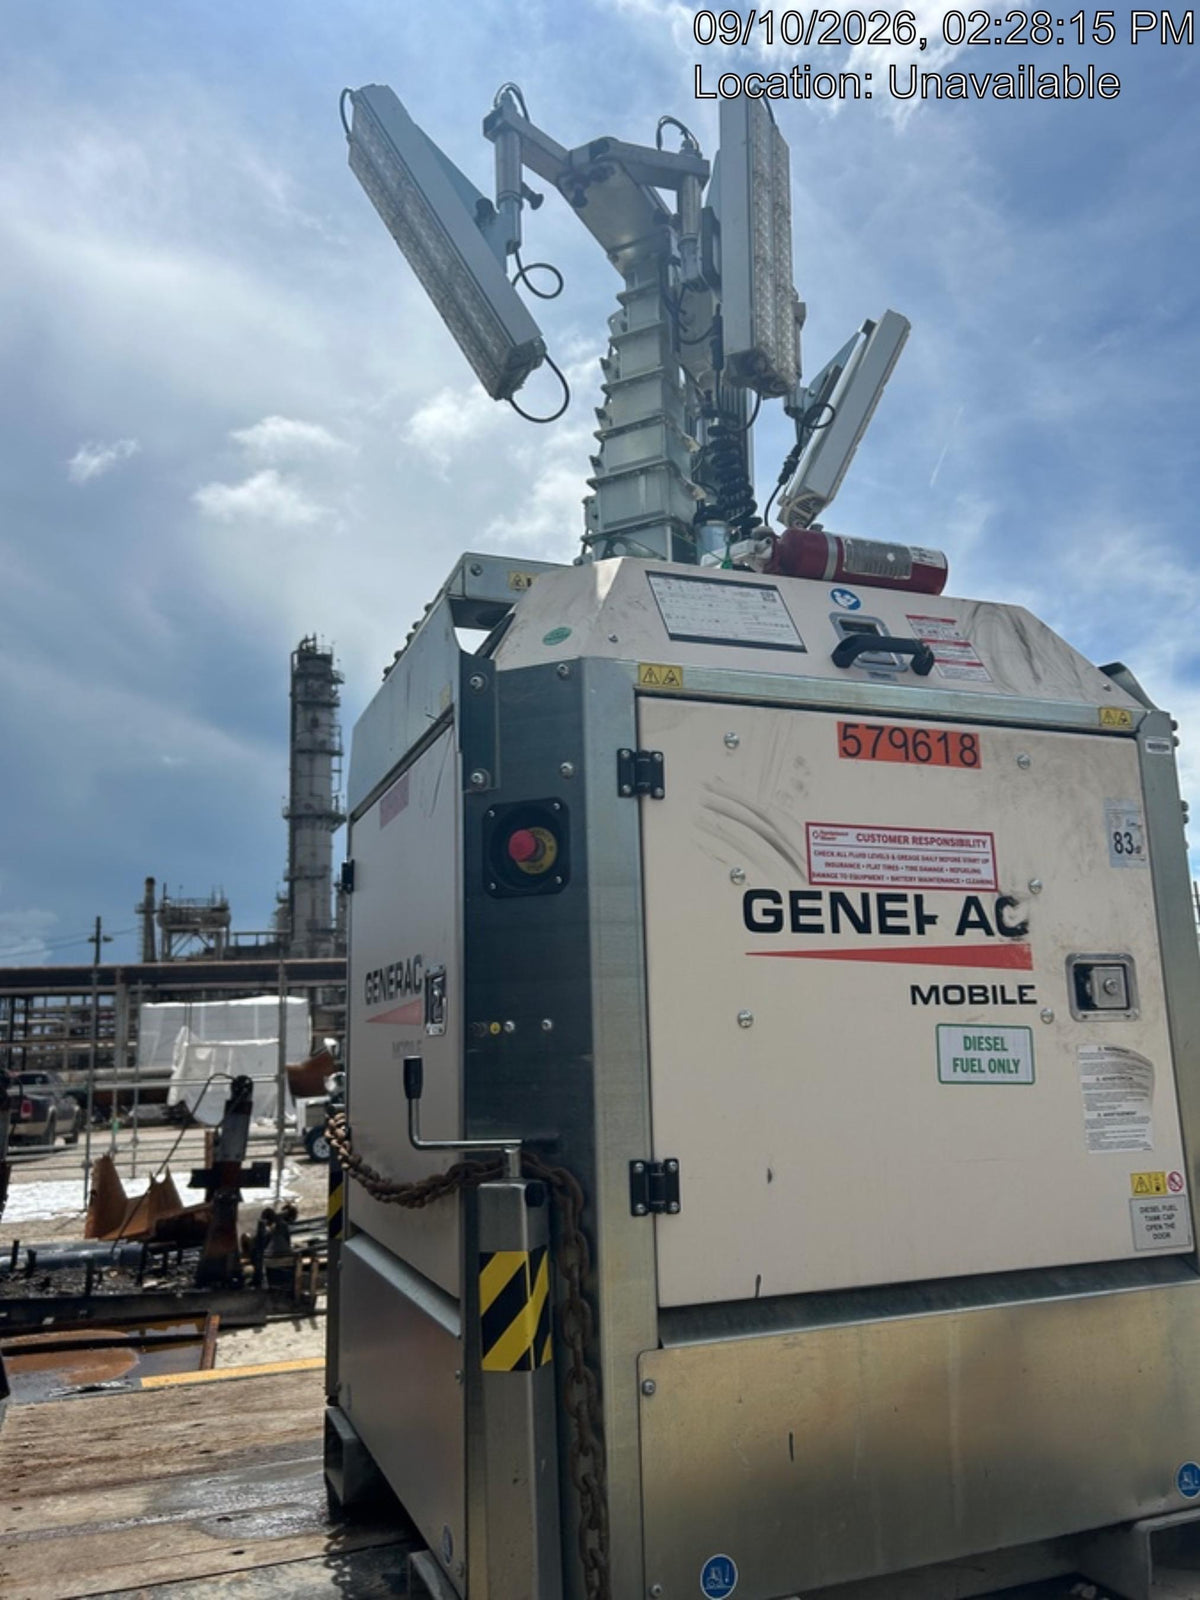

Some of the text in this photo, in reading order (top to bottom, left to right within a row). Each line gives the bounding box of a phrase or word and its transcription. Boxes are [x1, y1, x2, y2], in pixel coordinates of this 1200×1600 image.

[842, 723, 977, 766] 579618
[856, 833, 909, 846] CUSTOMER
[911, 835, 988, 849] RESPONSIBILITY
[824, 861, 861, 869] INSURANCE
[849, 873, 885, 881] EQUIPMENT
[918, 876, 961, 884] MAINTENANCE
[365, 953, 422, 1006] GENERAC
[910, 985, 1037, 1006] MOBILE
[963, 1035, 1009, 1052] DIESEL
[952, 1057, 1021, 1075] FUEL ONLY
